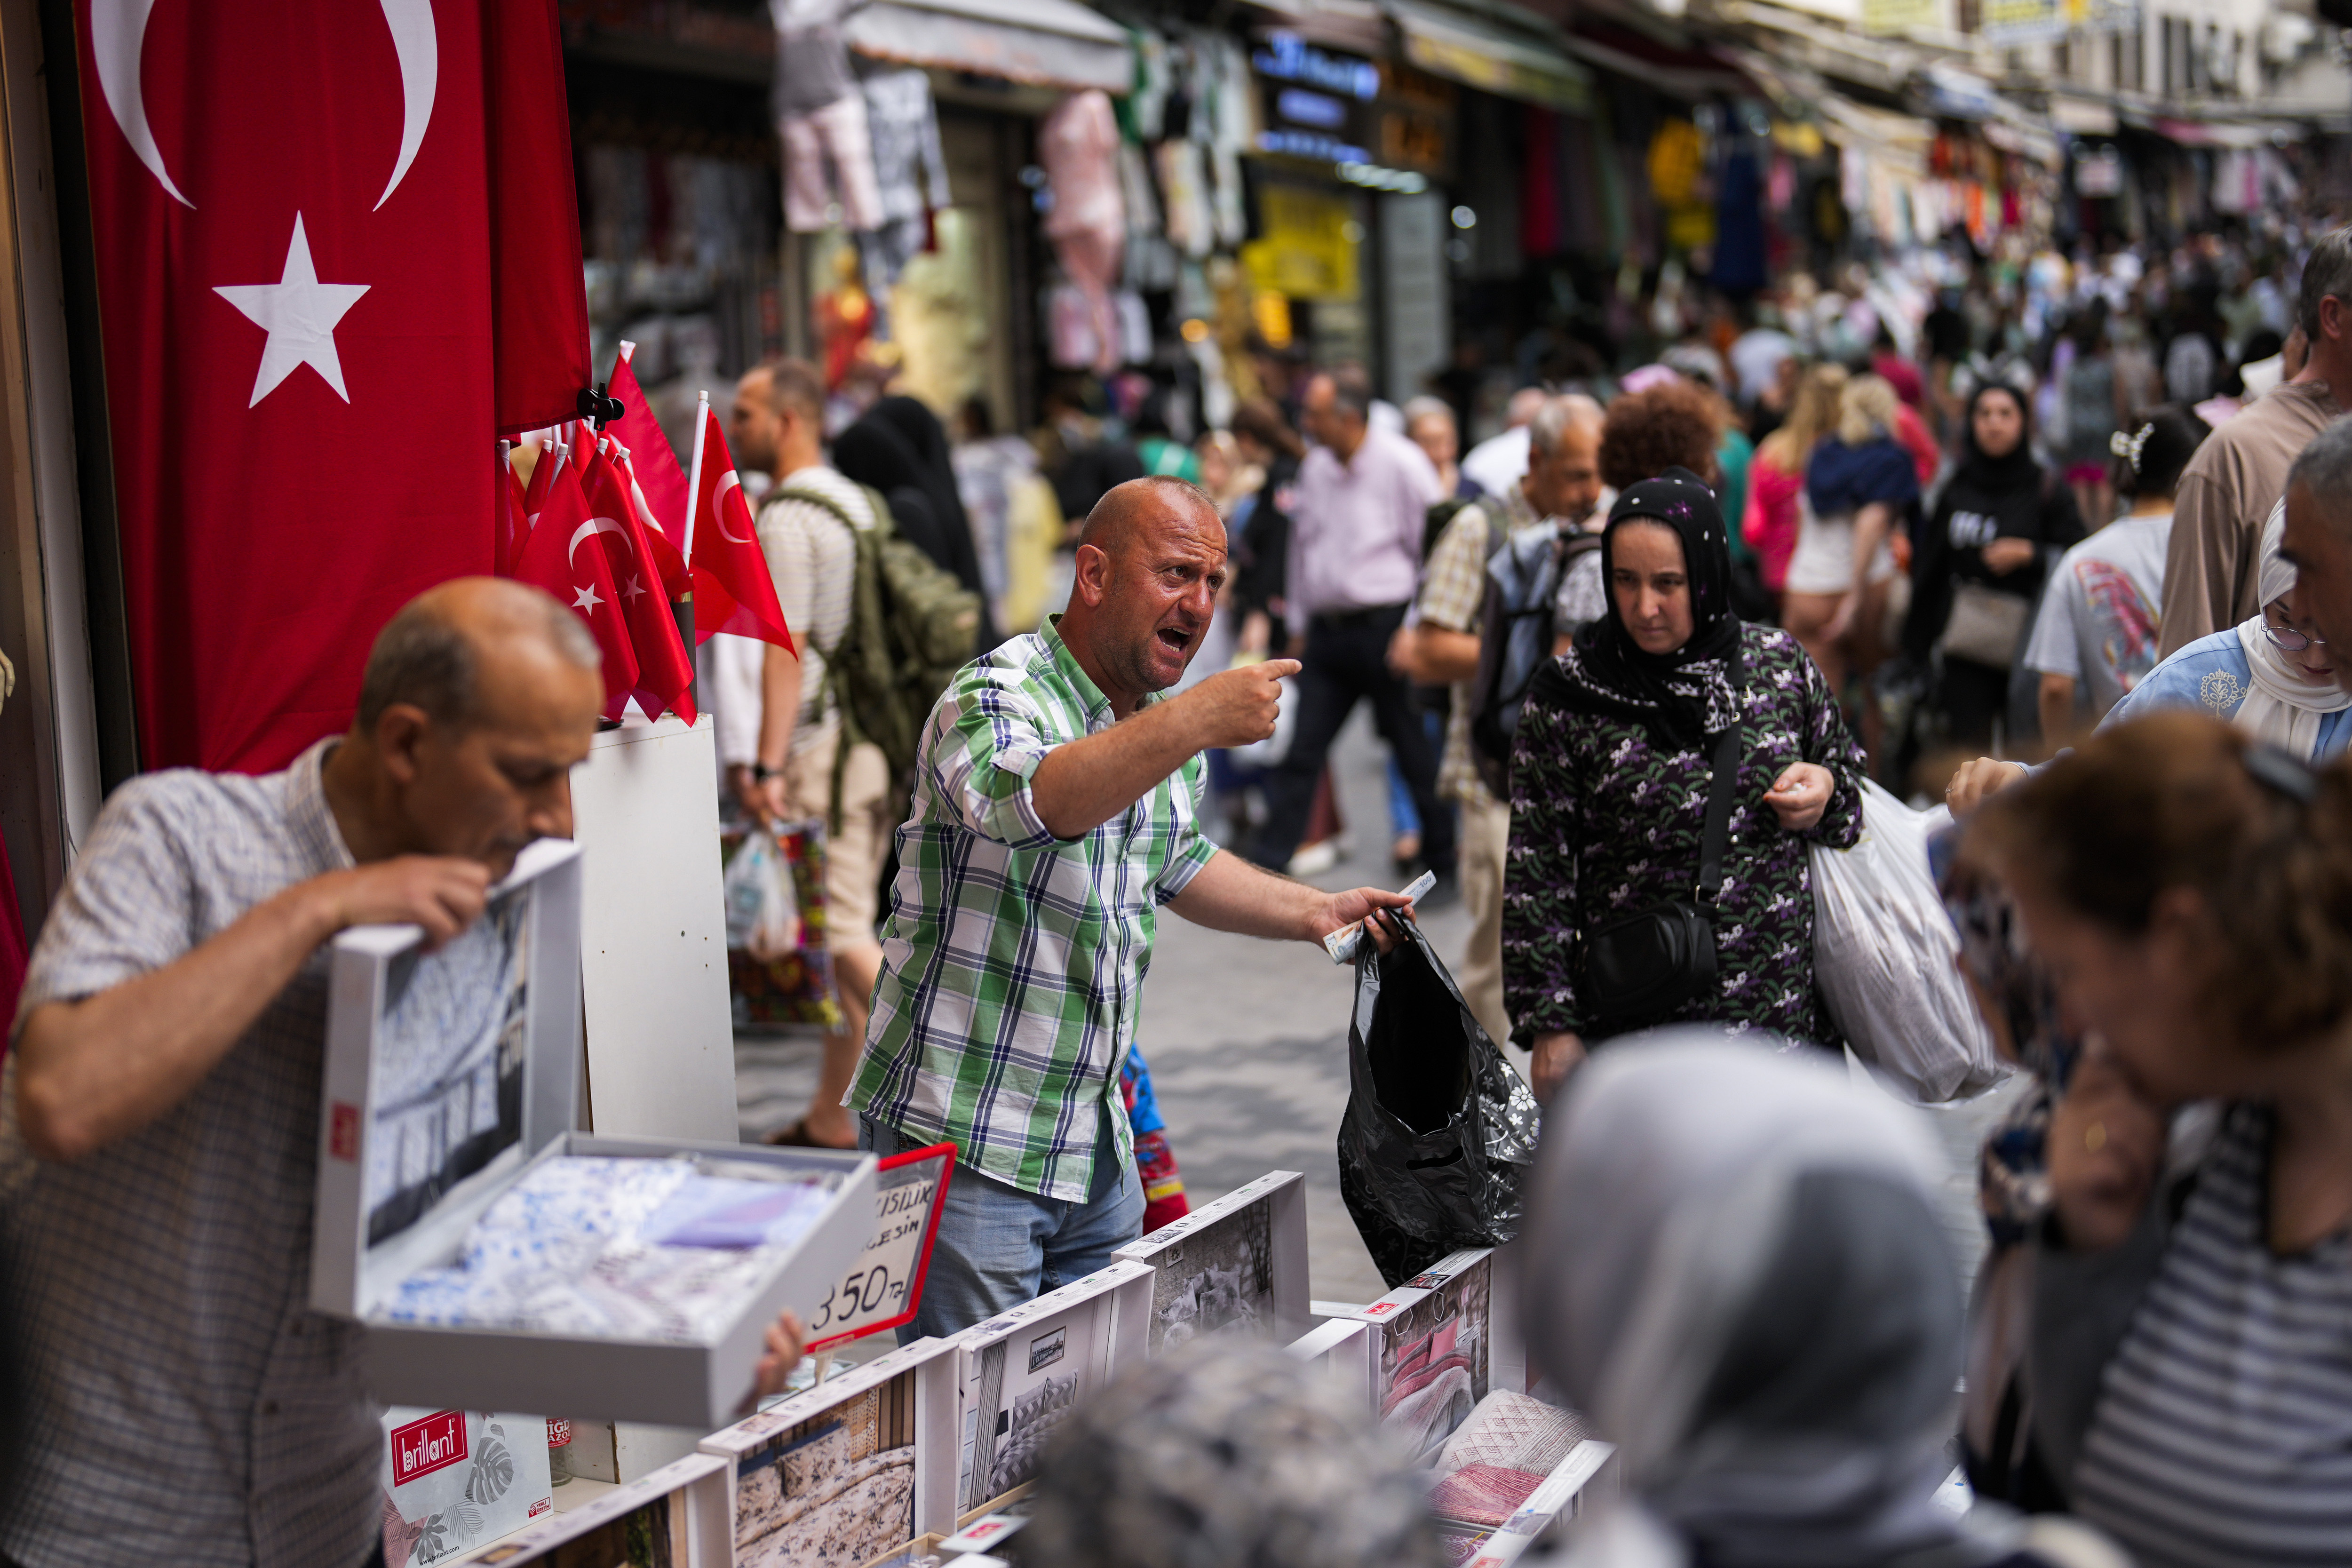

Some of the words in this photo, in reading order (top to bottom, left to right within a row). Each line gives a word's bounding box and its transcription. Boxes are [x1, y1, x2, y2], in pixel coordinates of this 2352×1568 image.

[1419, 876, 1431, 888] 100
[812, 1264, 888, 1330] 350
[546, 1419, 570, 1435] İĞD
[402, 1419, 454, 1472] brillant
[420, 1545, 460, 1566] www.brillant.com
